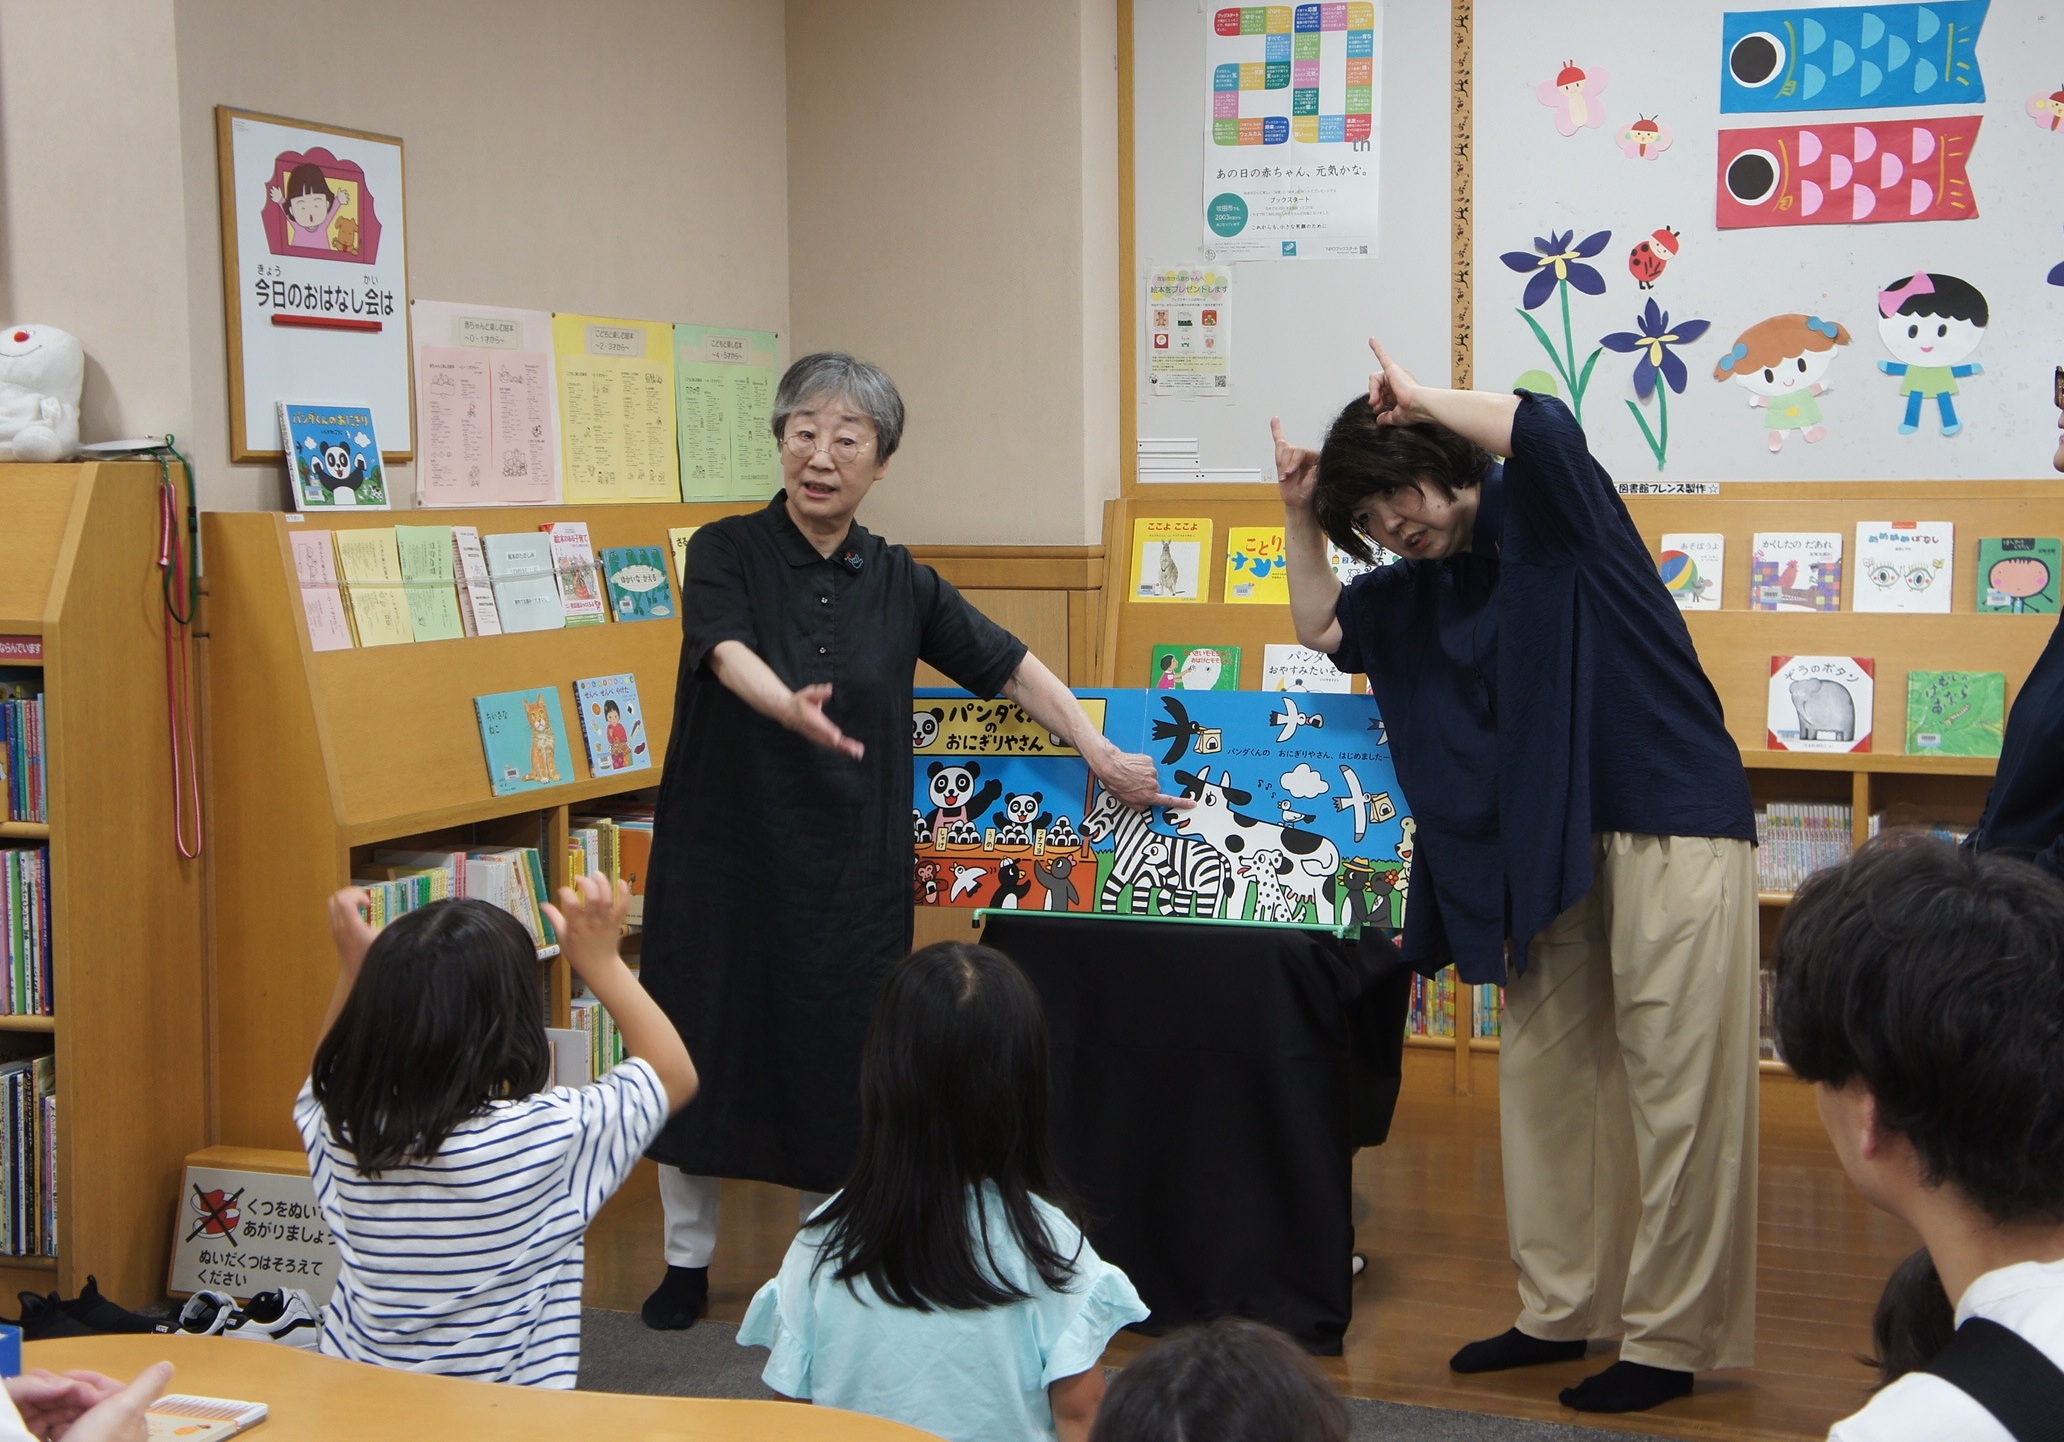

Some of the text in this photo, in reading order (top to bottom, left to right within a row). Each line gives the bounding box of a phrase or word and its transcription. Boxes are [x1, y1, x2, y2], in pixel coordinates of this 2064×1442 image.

[1216, 164, 1367, 180] あの日の赤ちゃん、元気かな。
[257, 264, 281, 277] きょう
[363, 274, 379, 285] かい
[1150, 285, 1228, 294] 絵本をプレゼントします
[255, 278, 394, 316] 今日のおはなし会は
[464, 320, 514, 333] 赤ちゃんと楽しむ絵本
[292, 411, 369, 427] パンダくんのおにぎり
[1148, 522, 1198, 531] ここよ ここよ
[1246, 535, 1282, 556] ことり
[1762, 540, 1832, 549] かくしたの だあれ
[1784, 662, 1860, 683] ぞうのボタン
[486, 709, 508, 721] ちいさな
[949, 702, 1034, 724] パンダく
[489, 725, 500, 735] ねこ
[985, 722, 997, 733] の
[946, 734, 1044, 752] おにぎりやさん
[1227, 748, 1271, 757] パンダくんの
[1278, 749, 1334, 760] おにぎりやさん、
[986, 831, 993, 848] うめ
[199, 1249, 323, 1276] ぬいだくつはそろえて
[198, 1269, 247, 1287] ください
